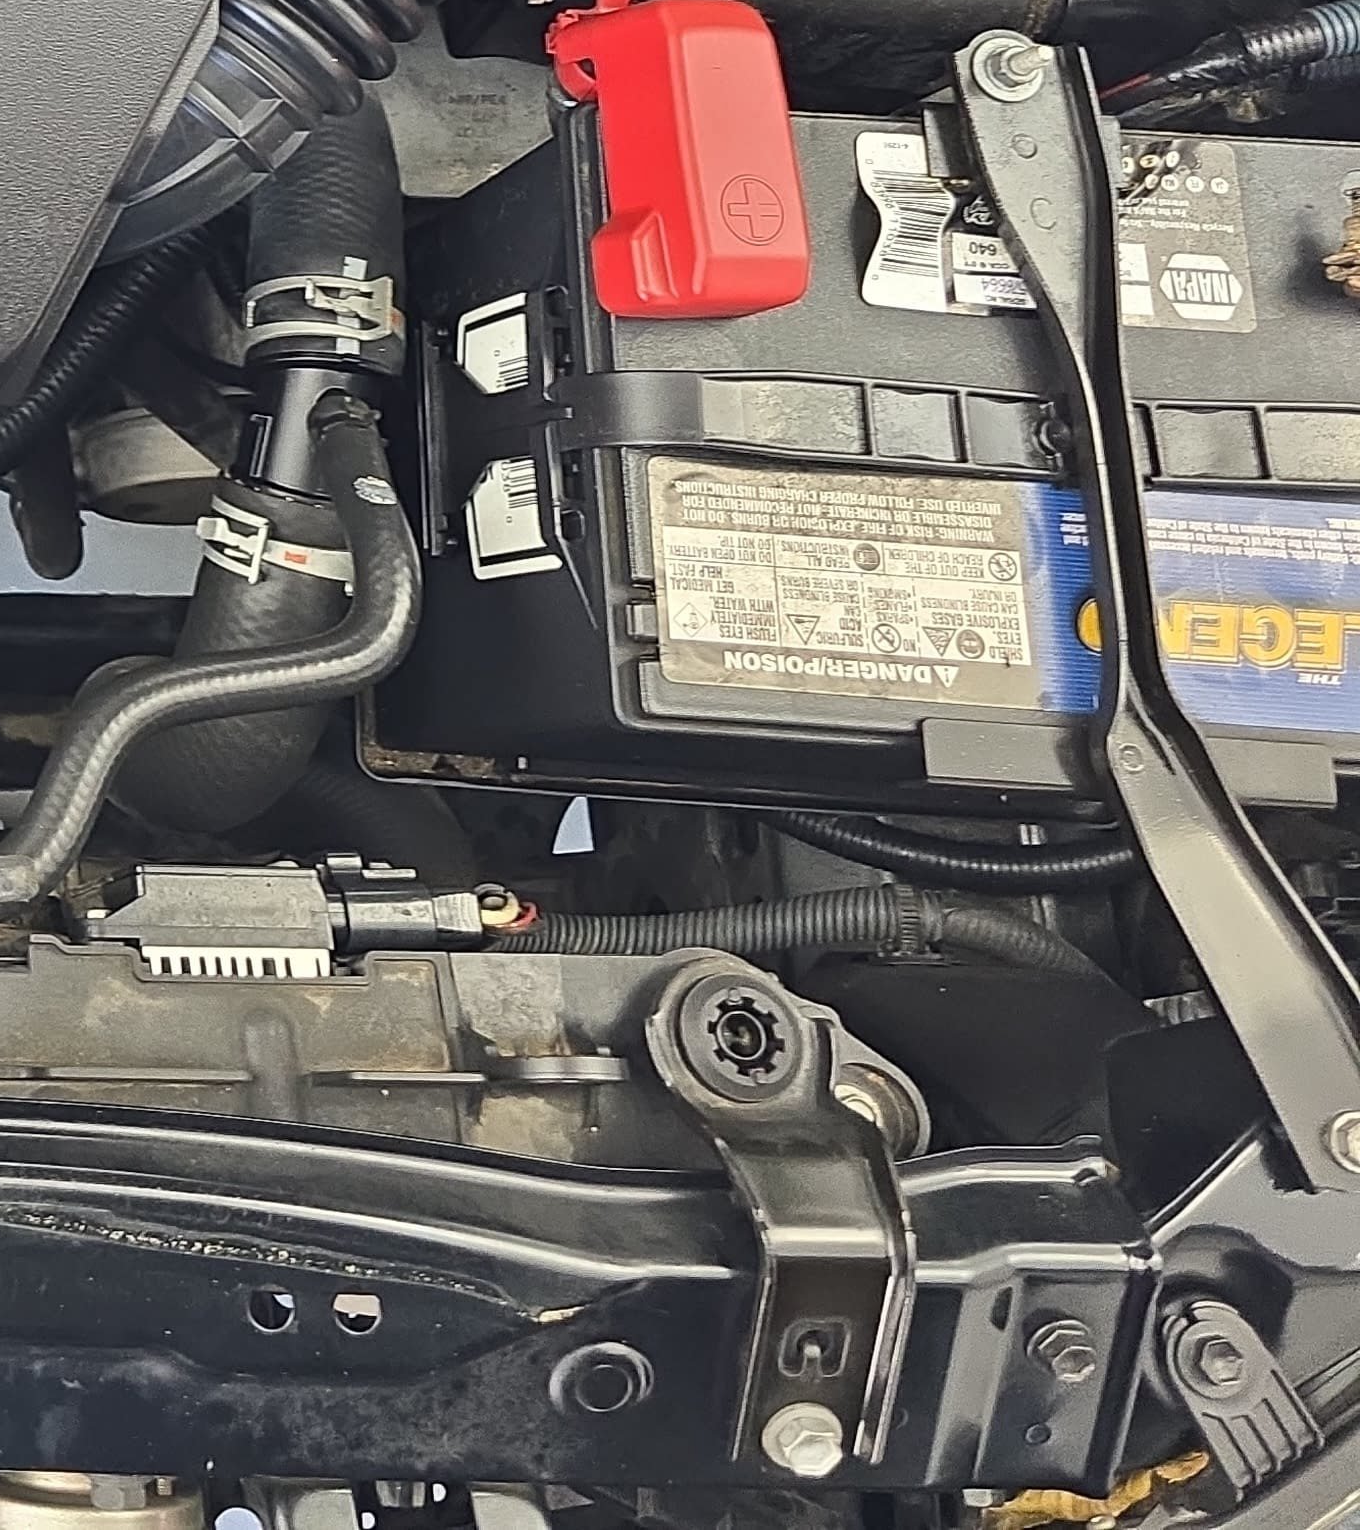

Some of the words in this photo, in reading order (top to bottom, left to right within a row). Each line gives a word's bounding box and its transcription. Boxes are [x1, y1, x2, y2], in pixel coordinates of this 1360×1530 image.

[969, 242, 997, 256] 640
[1172, 270, 1229, 304] NAPA
[682, 495, 705, 510] FOR
[888, 524, 902, 536] OF
[908, 524, 934, 538] RISK
[722, 650, 932, 685] DANGER/POISON
[1297, 673, 1342, 686] THE
